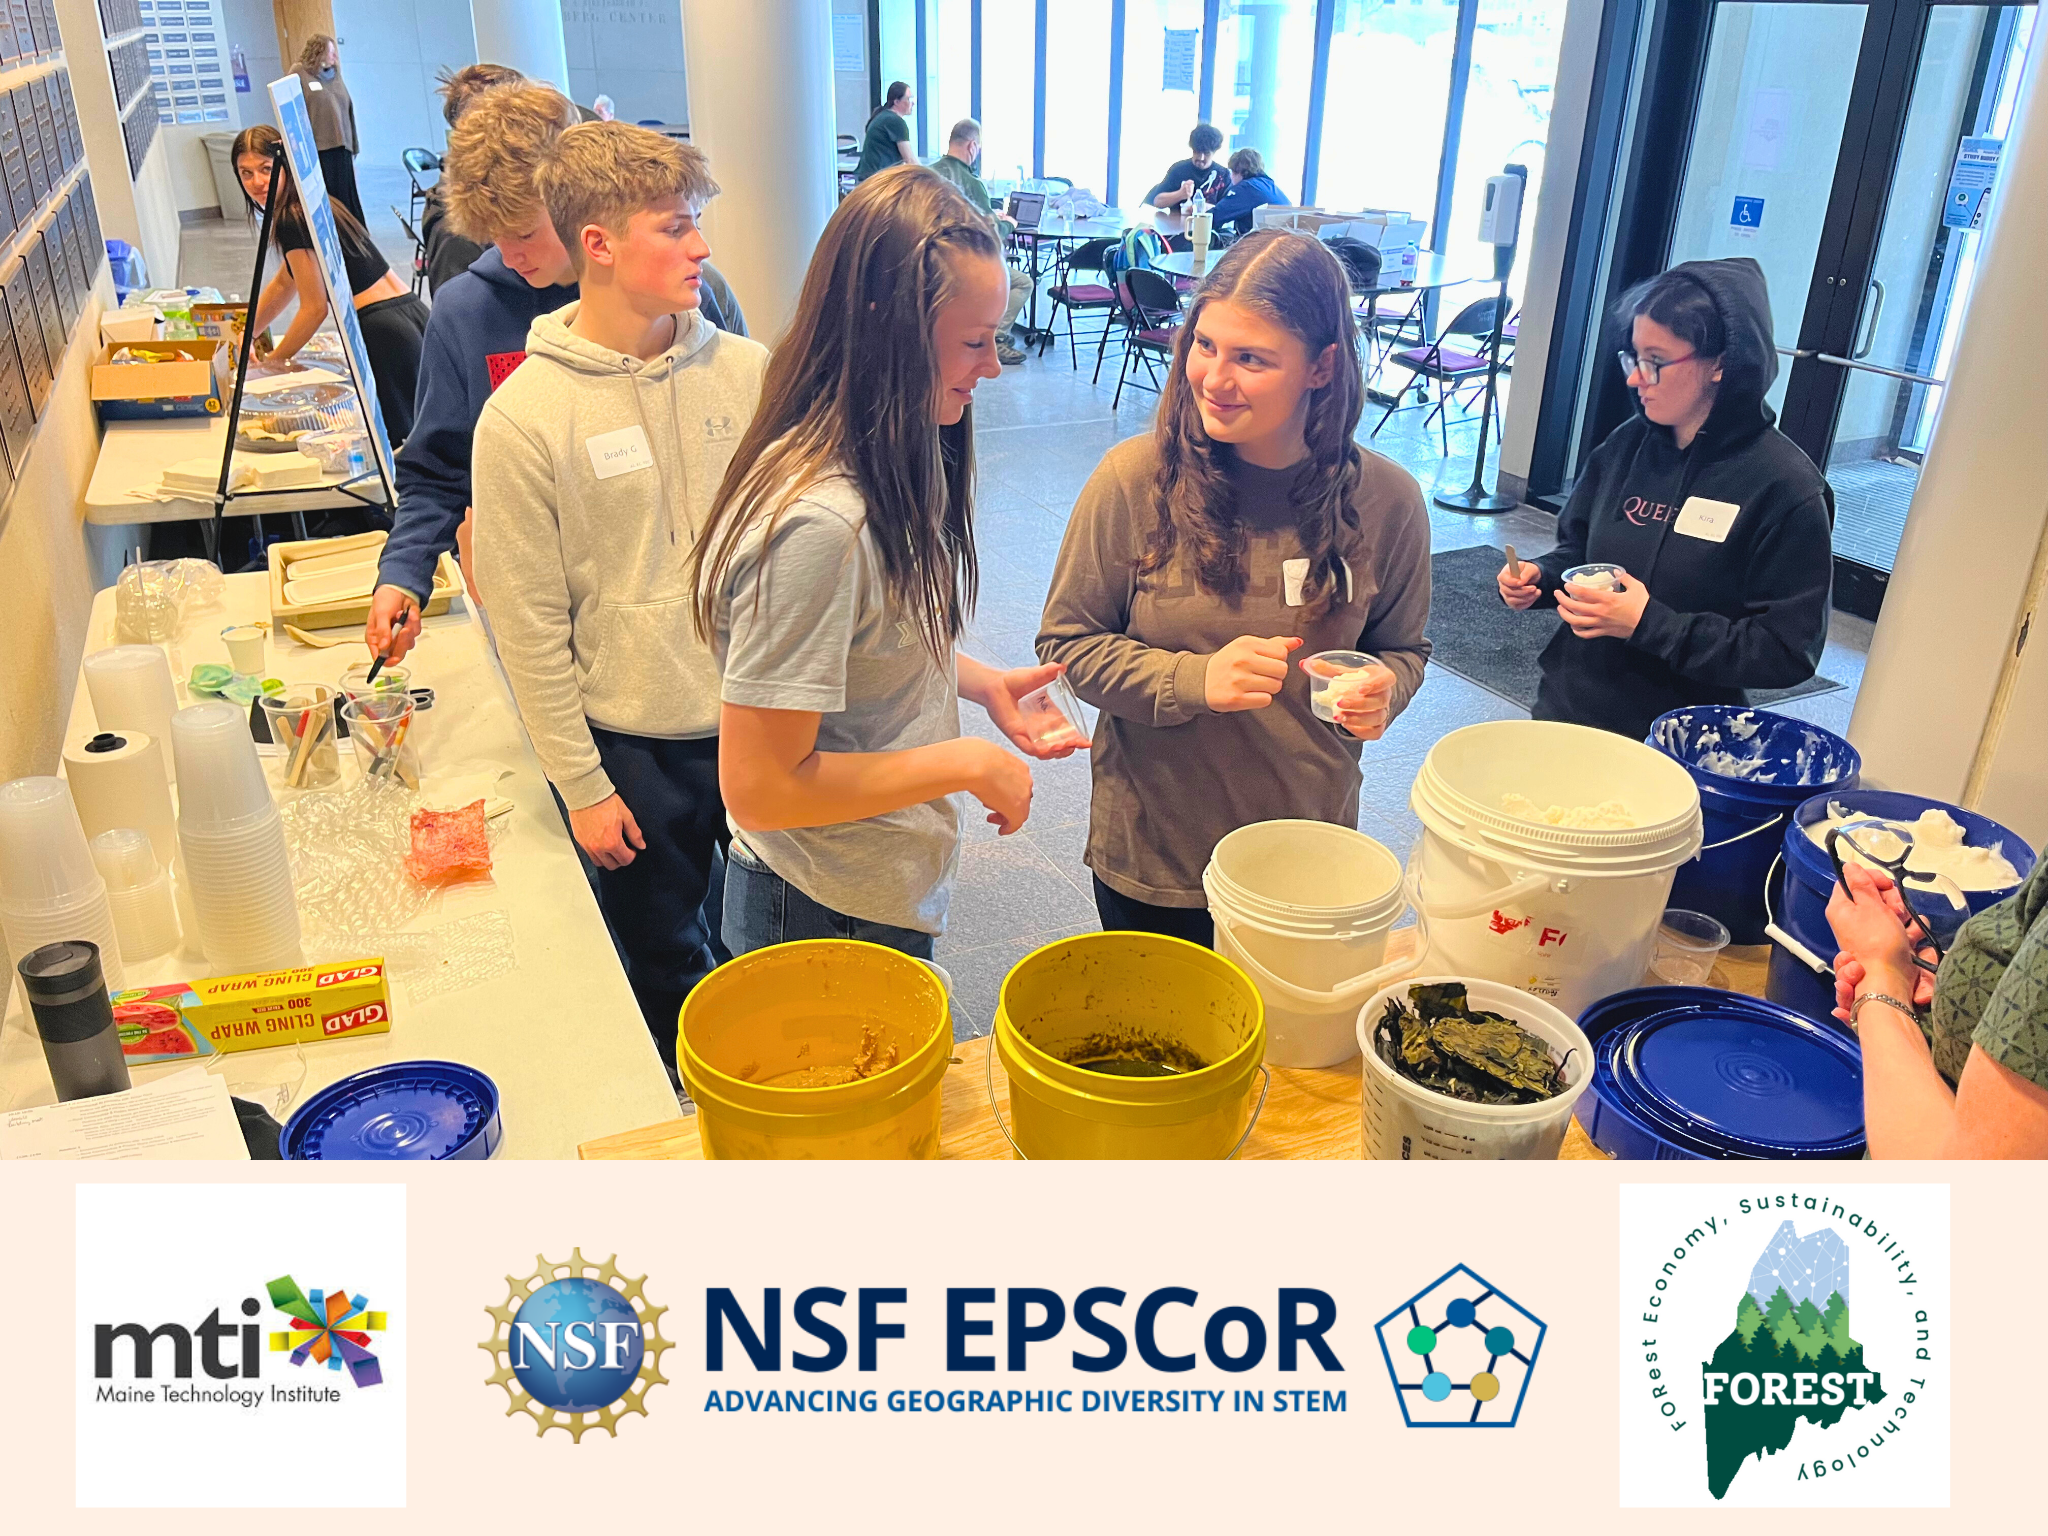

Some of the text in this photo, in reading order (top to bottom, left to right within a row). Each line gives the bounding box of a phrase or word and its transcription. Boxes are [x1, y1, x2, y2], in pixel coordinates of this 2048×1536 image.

[609, 12, 666, 24] CENTER
[603, 444, 638, 461] Brady G
[1698, 514, 1715, 524] Kira
[207, 973, 313, 995] CLING WRAP
[318, 966, 379, 985] GLAD
[287, 997, 313, 1010] 300
[210, 1013, 316, 1040] CLING WRAP
[324, 1004, 385, 1032] GLAD
